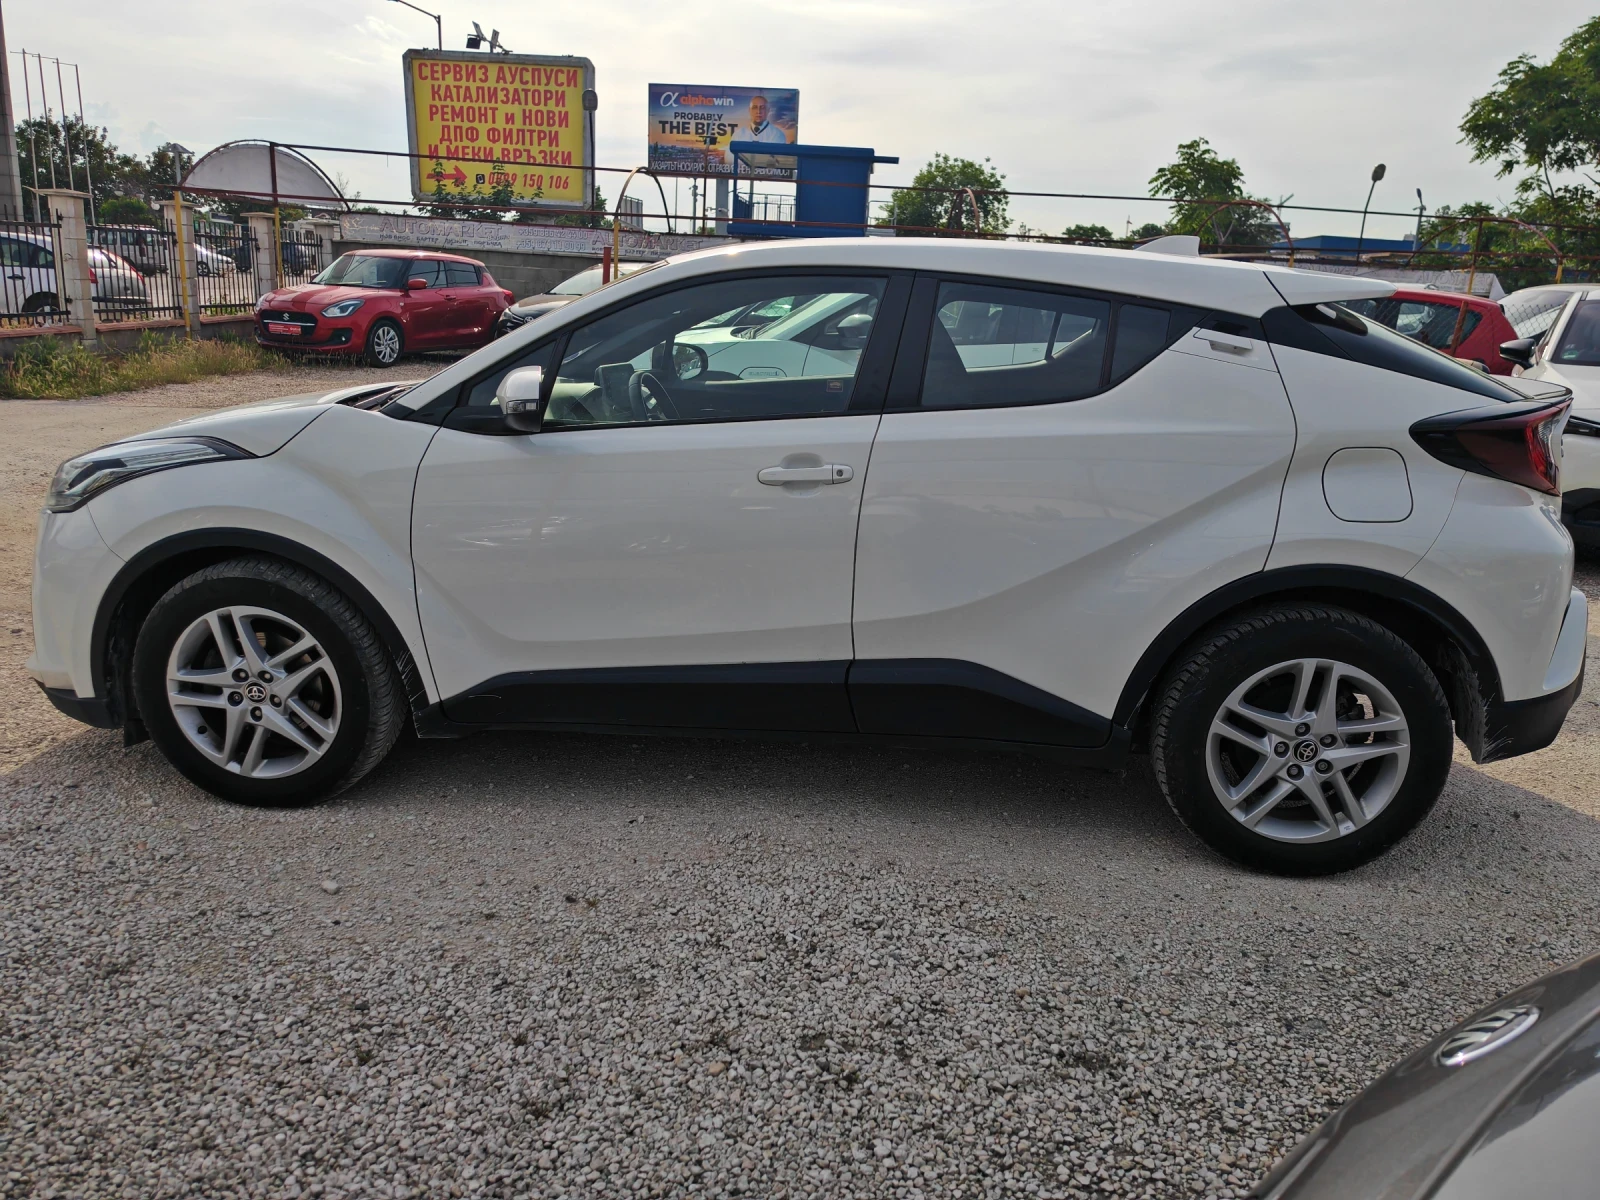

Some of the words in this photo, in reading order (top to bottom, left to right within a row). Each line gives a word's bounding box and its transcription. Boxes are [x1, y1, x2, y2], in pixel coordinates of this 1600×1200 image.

[418, 63, 489, 83] СЕРВИЗ
[495, 67, 578, 88] АУСПУСИ
[431, 84, 566, 108] КАТАЛИЗАТОРИ
[680, 94, 734, 107] alphawin
[429, 104, 498, 125] РЕМОНТ
[505, 112, 515, 126] и
[522, 108, 570, 129] НОВИ
[674, 111, 723, 121] PROBABLY
[439, 125, 480, 145] ДПФ
[486, 127, 560, 148] ФИЛТРИ
[659, 120, 691, 135] THE
[695, 122, 739, 137] BEST
[428, 144, 439, 161] И
[446, 145, 495, 163] МЕКИ
[500, 148, 573, 166] ВРЪЗКИ
[693, 163, 707, 172] РИС
[523, 173, 543, 188] 150
[549, 175, 570, 190] 106
[380, 216, 503, 239] AUTOMARKET
